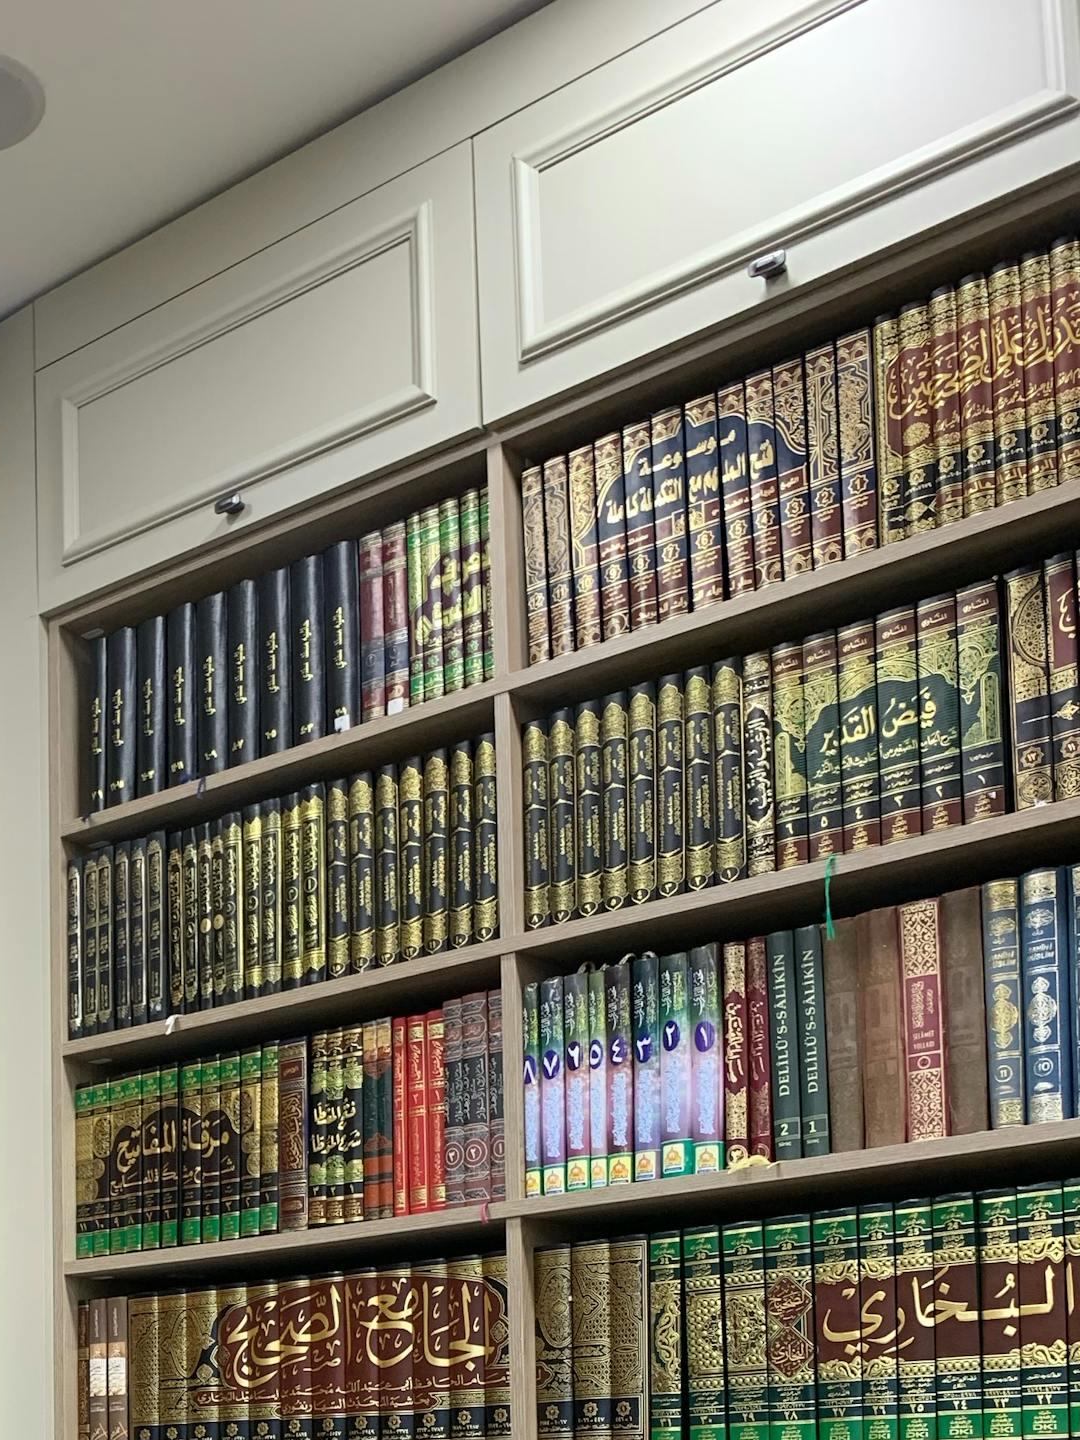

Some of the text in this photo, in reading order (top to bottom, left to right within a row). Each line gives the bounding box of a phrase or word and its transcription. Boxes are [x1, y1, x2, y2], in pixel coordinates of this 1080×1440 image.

[637, 429, 737, 477] موسوعة
[749, 439, 775, 480] فتح
[820, 685, 937, 755] فيض القدير
[979, 774, 985, 786] ١
[936, 785, 943, 797] ٢
[894, 795, 904, 807] ٣
[855, 806, 863, 820] ٤
[785, 823, 794, 834] ٦
[820, 817, 829, 827] ٥
[773, 954, 790, 1097] DELİLÜ'S-SÂLİKİN
[800, 950, 819, 1094] DELİLÜ'S-SÂLİKİN
[666, 1024, 675, 1043] ٢
[700, 1028, 708, 1041] ١
[567, 1045, 580, 1066] ٦
[589, 1045, 600, 1065] ٥
[611, 1040, 622, 1062] ٤
[637, 1038, 652, 1058] ٣
[523, 1059, 536, 1085] ٨
[543, 1057, 558, 1073] ٧
[1038, 1061, 1049, 1072] 10
[999, 1068, 1008, 1079] 11
[779, 1123, 789, 1136] 2
[808, 1121, 817, 1134] 1
[115, 1115, 231, 1173] مرقاة المفاتيح
[194, 1155, 236, 1184] شرح
[823, 1263, 1076, 1355] البخاري
[226, 1277, 496, 1389] الجامع الصحيح
[869, 1430, 891, 1440] DKI
[905, 1428, 930, 1440] DKI
[948, 1426, 974, 1438] DKI
[990, 1424, 1015, 1436] DKI
[1032, 1422, 1058, 1434] DKI
